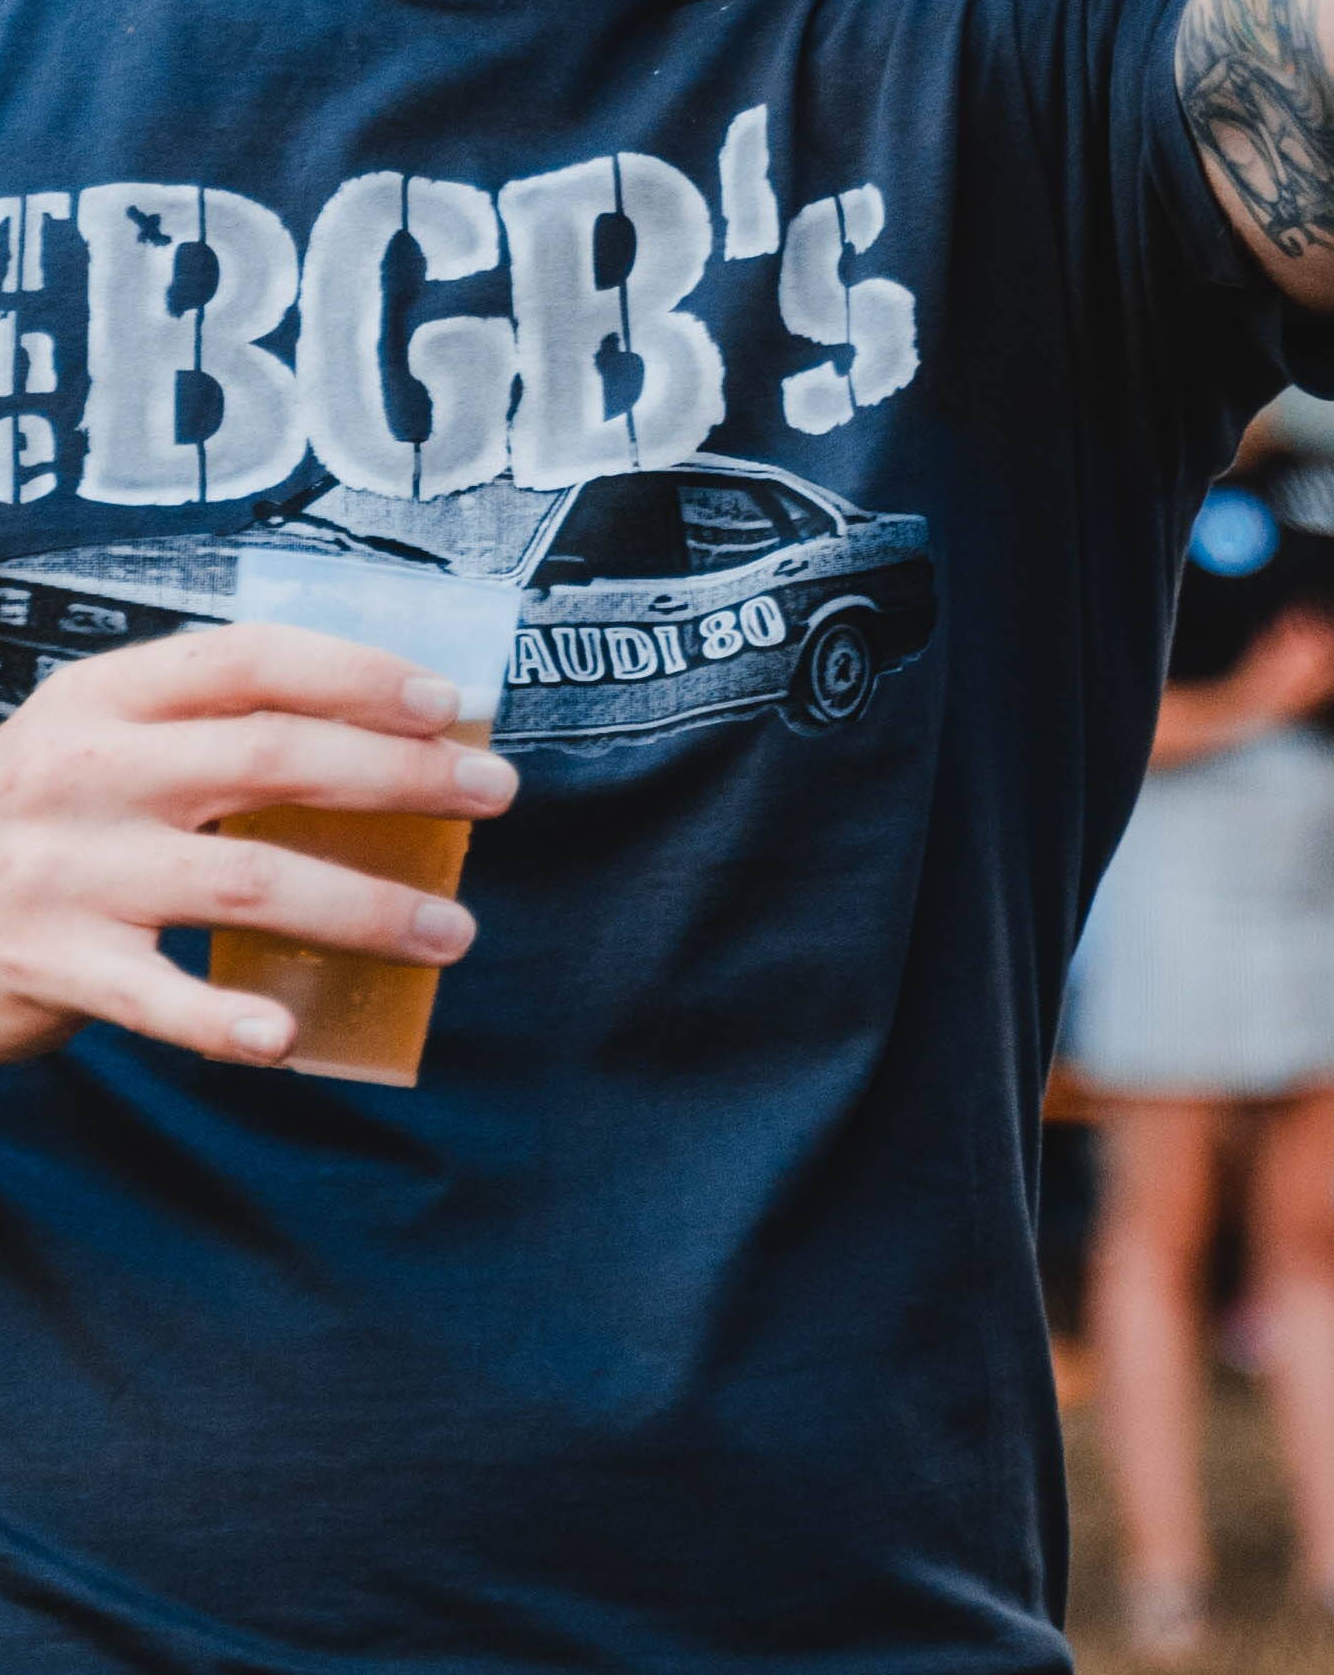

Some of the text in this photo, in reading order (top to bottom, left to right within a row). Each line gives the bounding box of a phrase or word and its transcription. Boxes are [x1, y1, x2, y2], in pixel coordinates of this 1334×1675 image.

[75, 103, 920, 505] BGB's
[507, 594, 787, 685] AUDI 80
